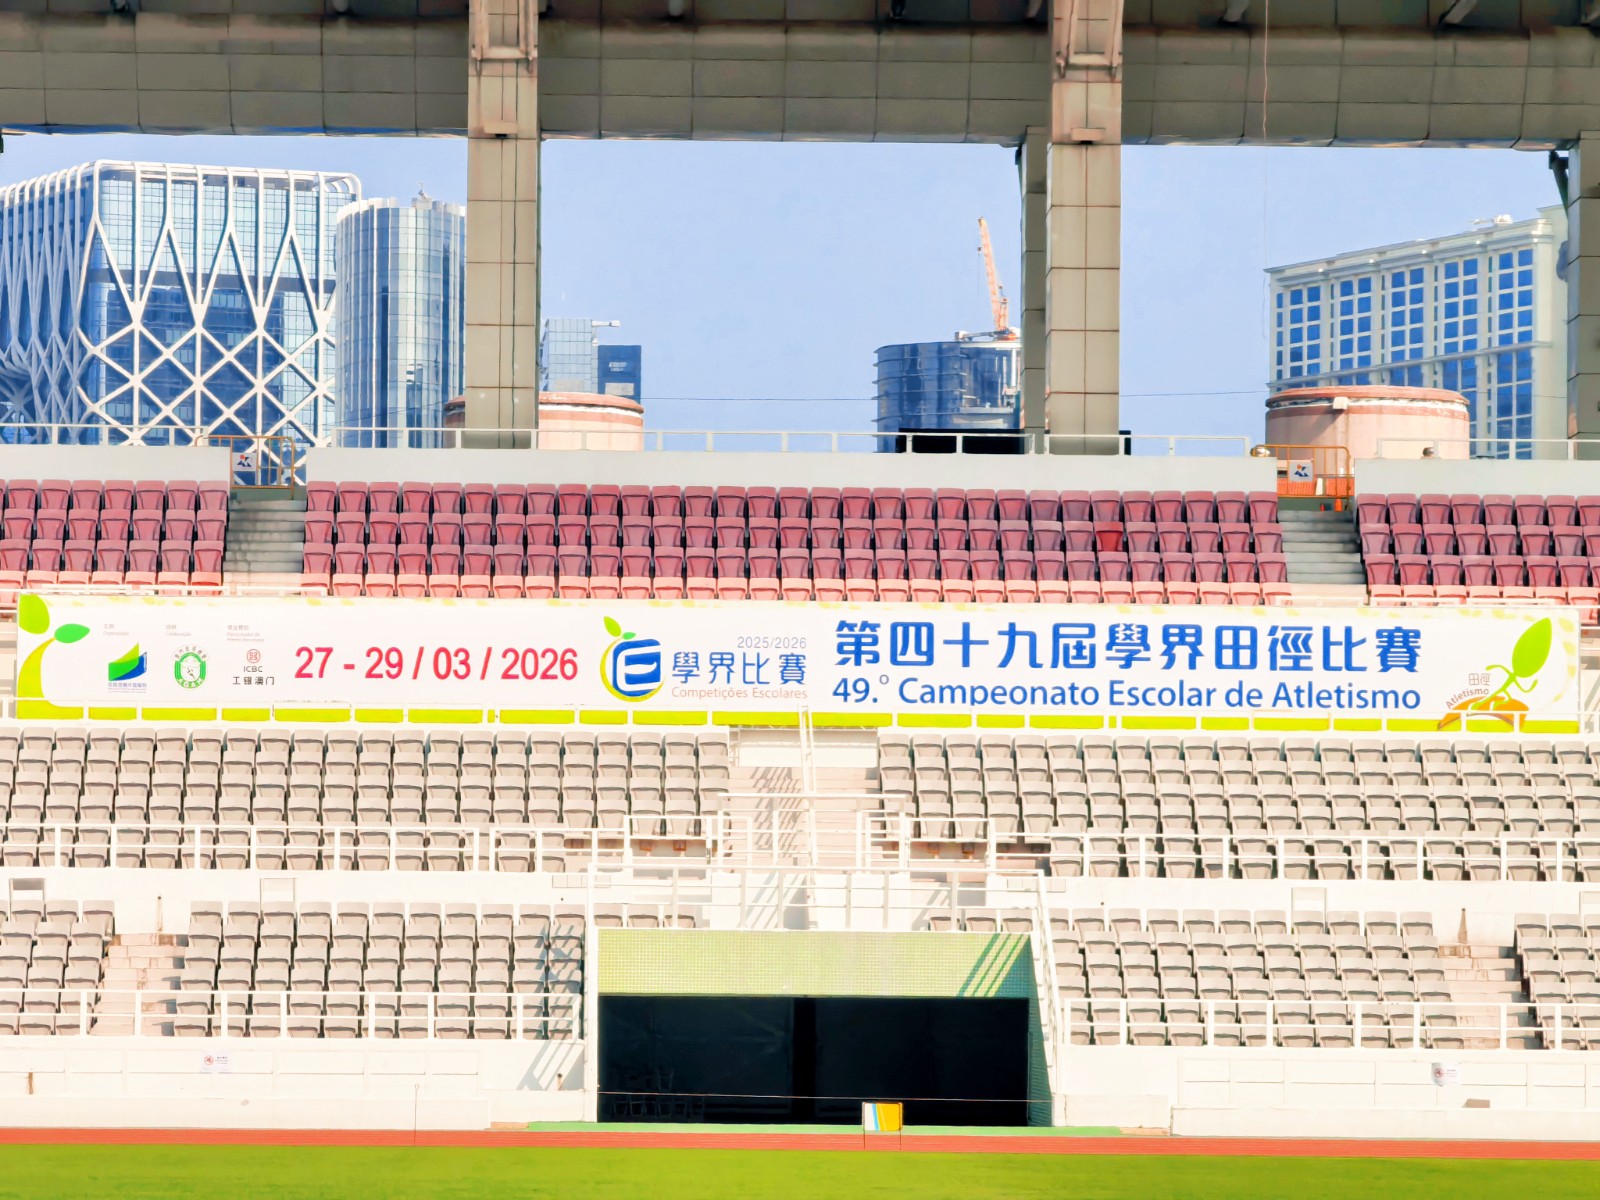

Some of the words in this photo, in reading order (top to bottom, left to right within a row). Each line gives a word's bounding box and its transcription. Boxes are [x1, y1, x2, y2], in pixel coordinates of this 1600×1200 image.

[737, 637, 807, 650] 2025/2026
[834, 620, 1421, 672] 第四十九屆學界田徑比賽
[243, 665, 263, 673] ICBC
[295, 646, 333, 679] 27
[365, 647, 403, 680] 29
[411, 646, 424, 680] /
[433, 647, 472, 681] 03
[480, 647, 492, 681] /
[501, 648, 578, 681] 2026
[672, 652, 806, 685] 學界比賽
[1468, 672, 1491, 686] 田徑
[672, 686, 748, 701] Competições
[753, 687, 808, 699] Escolares
[899, 676, 1100, 706] Campeonato
[1108, 678, 1218, 707] Escolar
[1224, 680, 1263, 708] de
[1272, 681, 1421, 709] Atletismo
[1445, 687, 1490, 710] Atletismo
